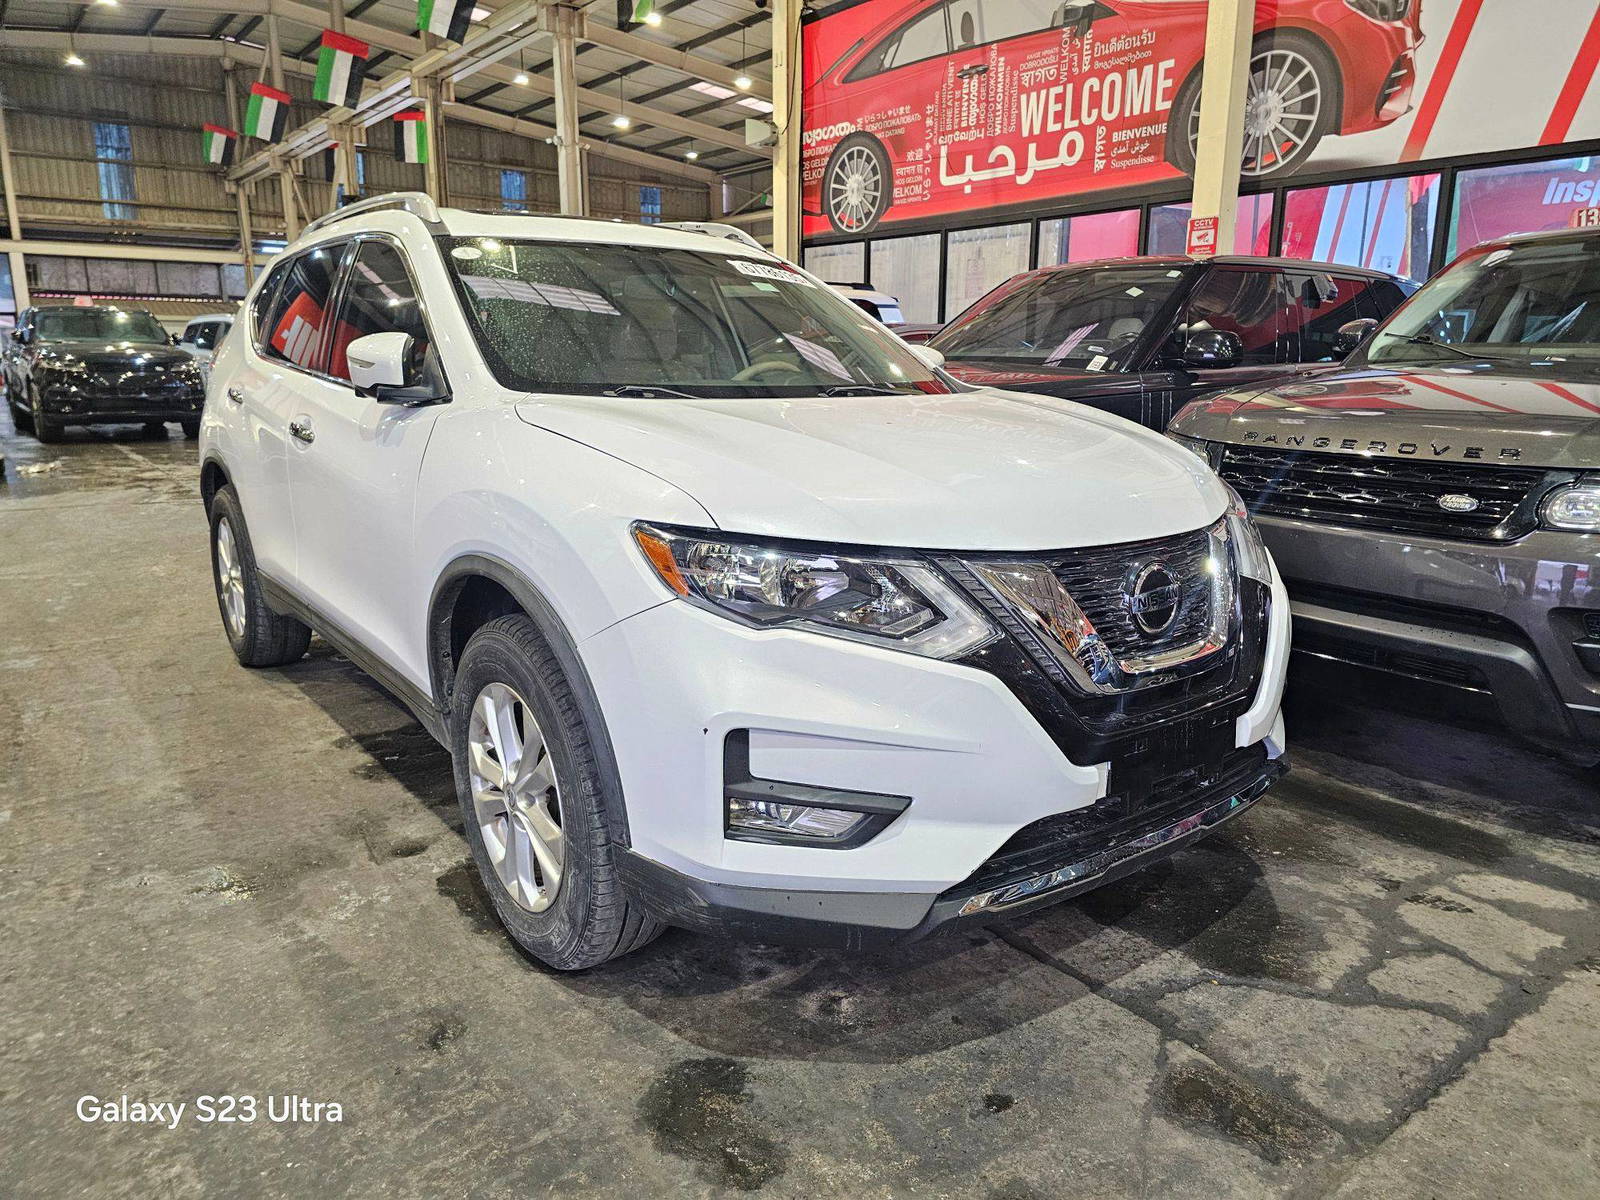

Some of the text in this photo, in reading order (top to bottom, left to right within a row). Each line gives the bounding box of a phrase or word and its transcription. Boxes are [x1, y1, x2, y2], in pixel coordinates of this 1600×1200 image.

[1060, 27, 1071, 83] WELKOM
[1094, 28, 1156, 57] ยินดีต้อนรับ
[961, 64, 970, 127] BIENVENE
[995, 57, 1005, 136] WILLKOMMEN
[1020, 64, 1059, 88] স্বাগত
[1020, 59, 1175, 138] WELCOME
[1008, 70, 1019, 132] Suspendisse
[1094, 125, 1106, 173] স্বাগত
[1112, 123, 1167, 142] BIENVENUE
[1130, 139, 1150, 154] خوش
[939, 131, 1085, 194] مرحبا
[1110, 154, 1155, 169] Suspendisse
[1137, 586, 1178, 609] NISSAN
